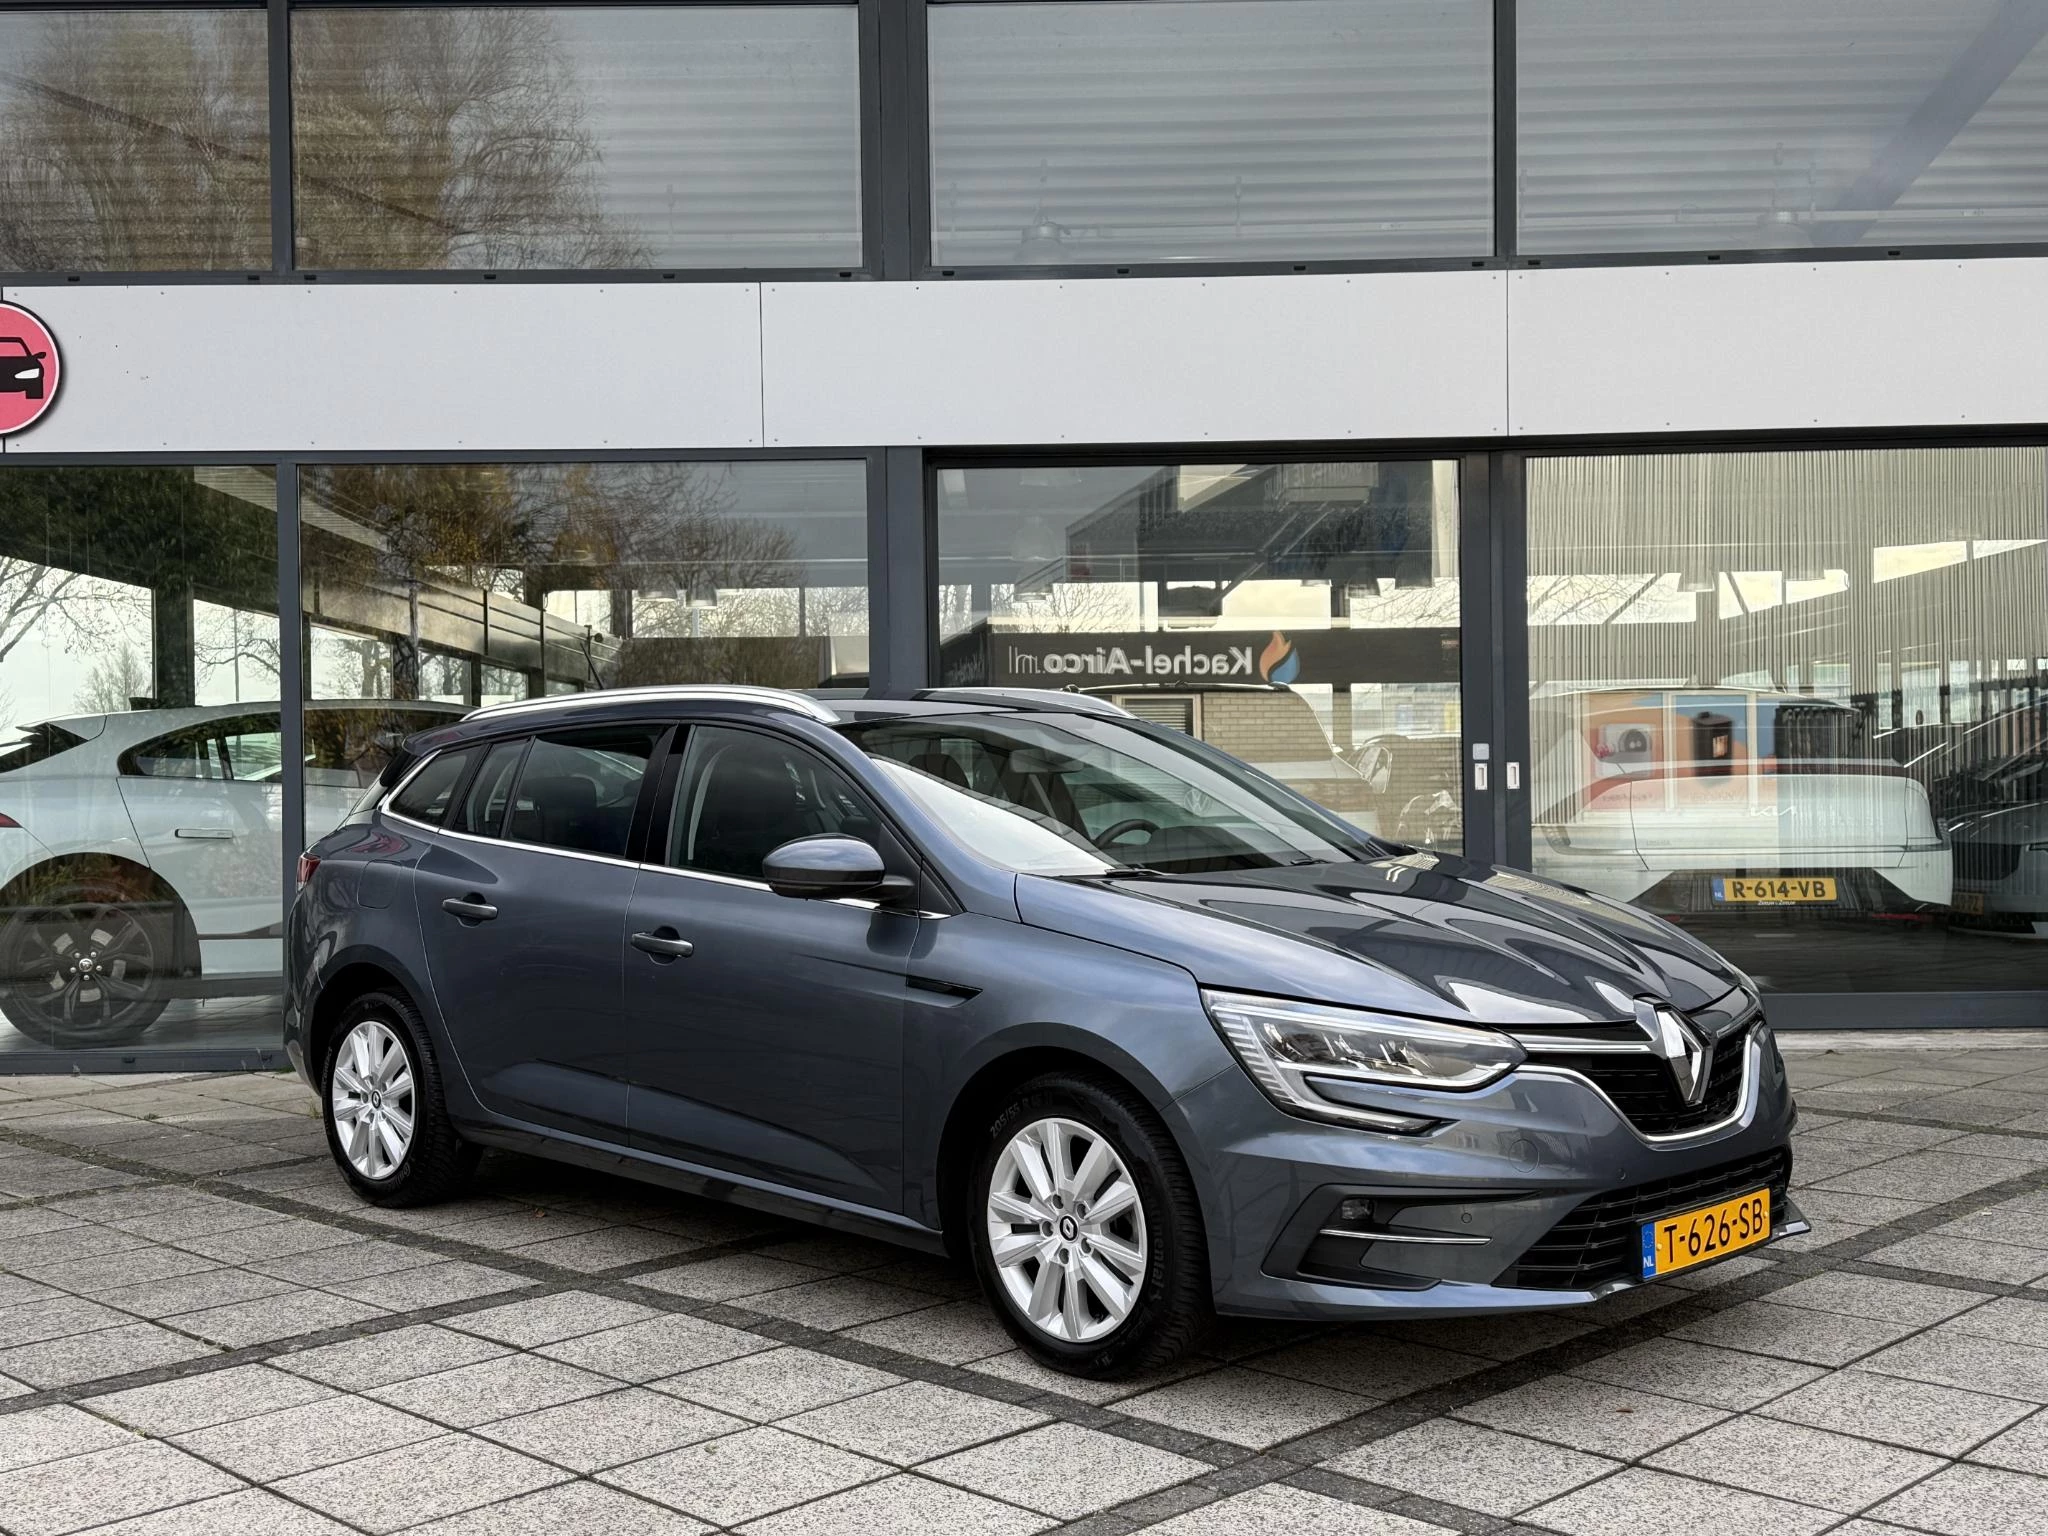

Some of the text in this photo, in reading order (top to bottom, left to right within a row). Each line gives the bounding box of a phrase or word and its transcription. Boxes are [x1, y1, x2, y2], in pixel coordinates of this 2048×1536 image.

[1732, 880, 1826, 899] R-614-VB
[1643, 1197, 1763, 1269] NL T-626-SB
